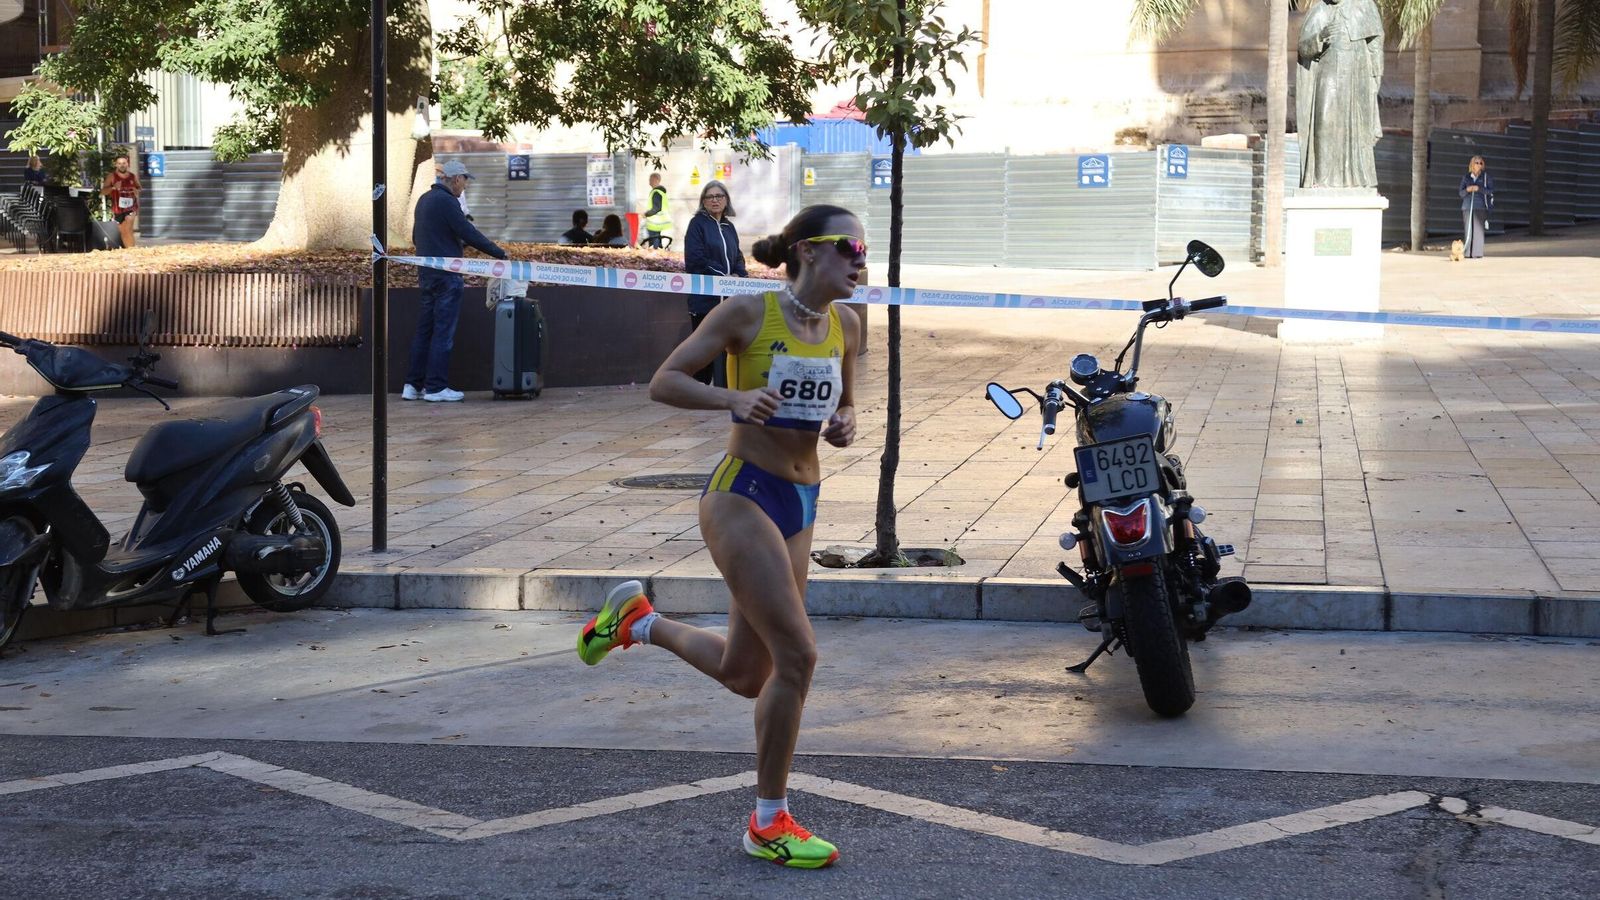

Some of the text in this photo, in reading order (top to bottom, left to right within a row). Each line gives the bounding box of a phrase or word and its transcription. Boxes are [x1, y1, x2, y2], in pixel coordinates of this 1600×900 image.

[780, 378, 832, 401] 680
[1096, 443, 1151, 471] 6492
[1086, 469, 1095, 478] E
[1107, 467, 1148, 494] LCD
[183, 536, 222, 572] YAMAHA
